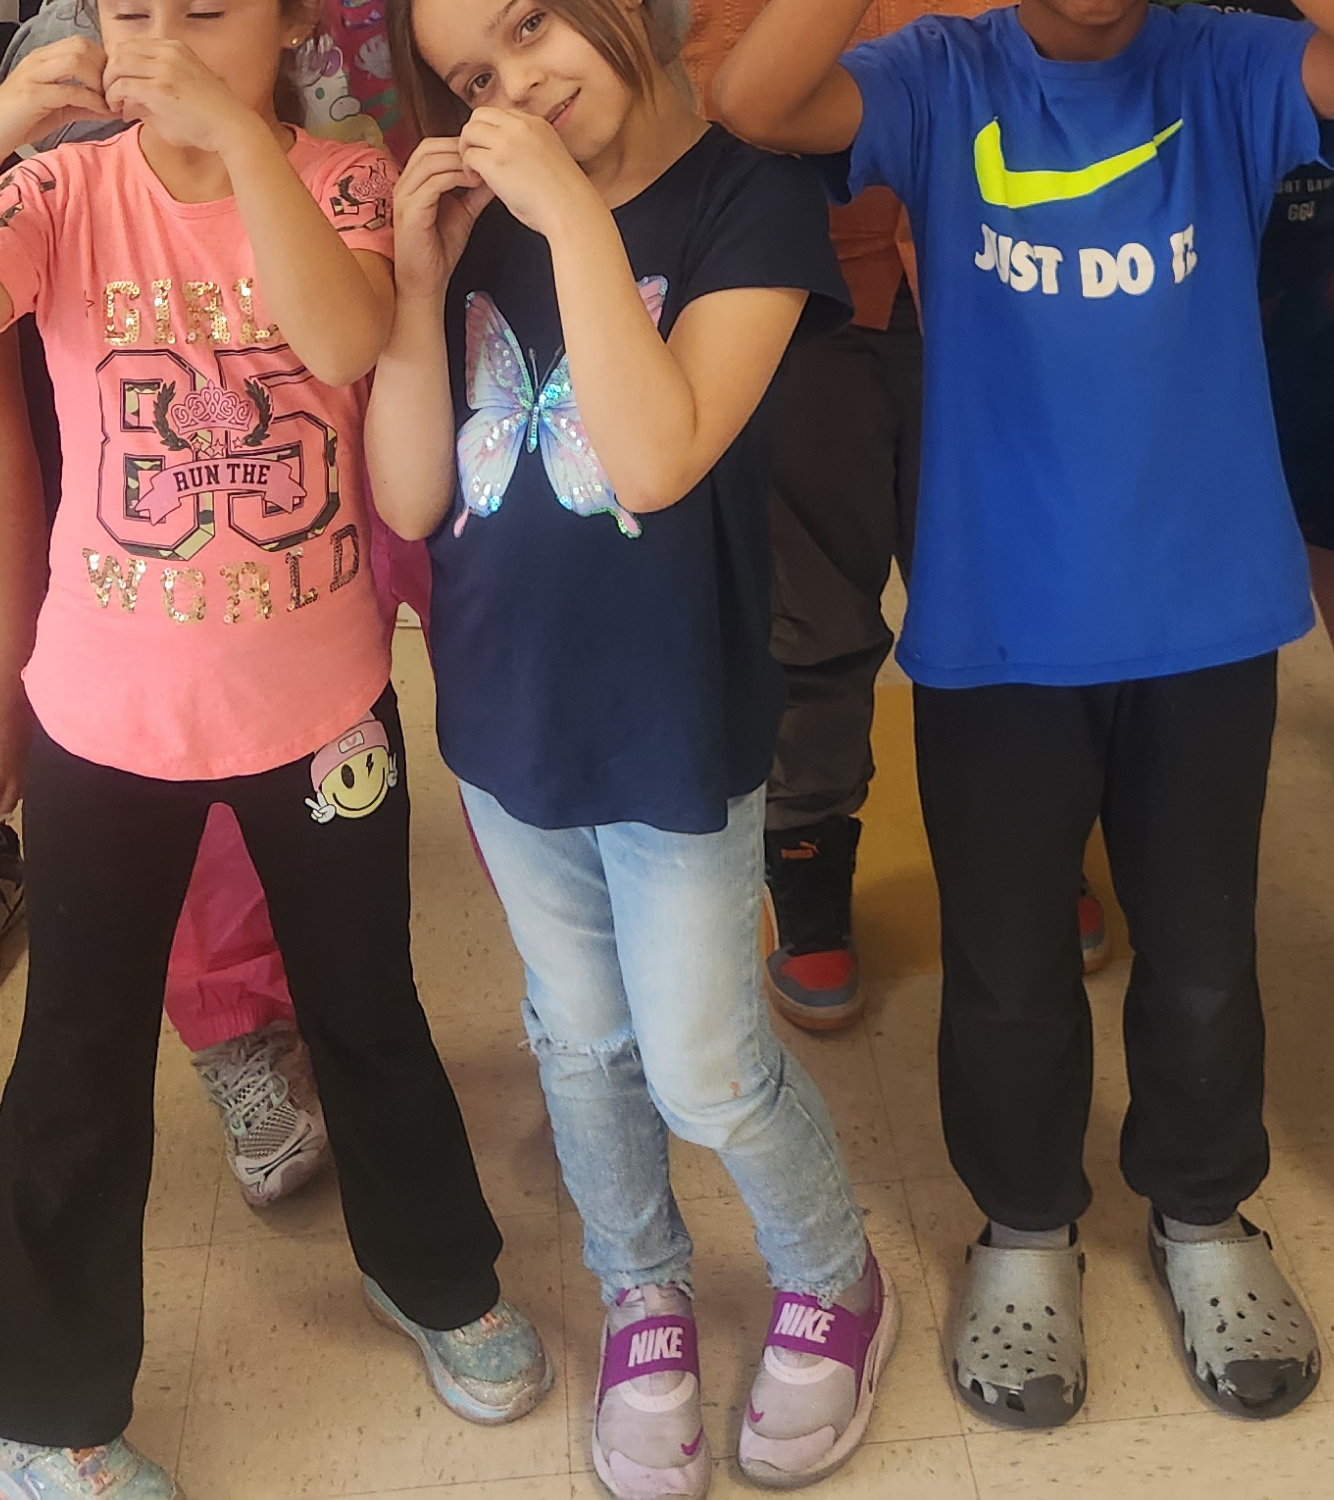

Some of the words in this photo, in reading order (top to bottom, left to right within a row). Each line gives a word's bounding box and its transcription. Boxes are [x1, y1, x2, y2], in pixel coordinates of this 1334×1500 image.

[974, 223, 1063, 295] JUST
[1078, 242, 1155, 298] DO
[104, 277, 280, 346] GIRL
[173, 463, 220, 492] RUN
[227, 462, 271, 485] THE
[83, 523, 360, 624] WORLD
[628, 1327, 683, 1367] NIKE
[774, 1303, 835, 1343] NIKE
